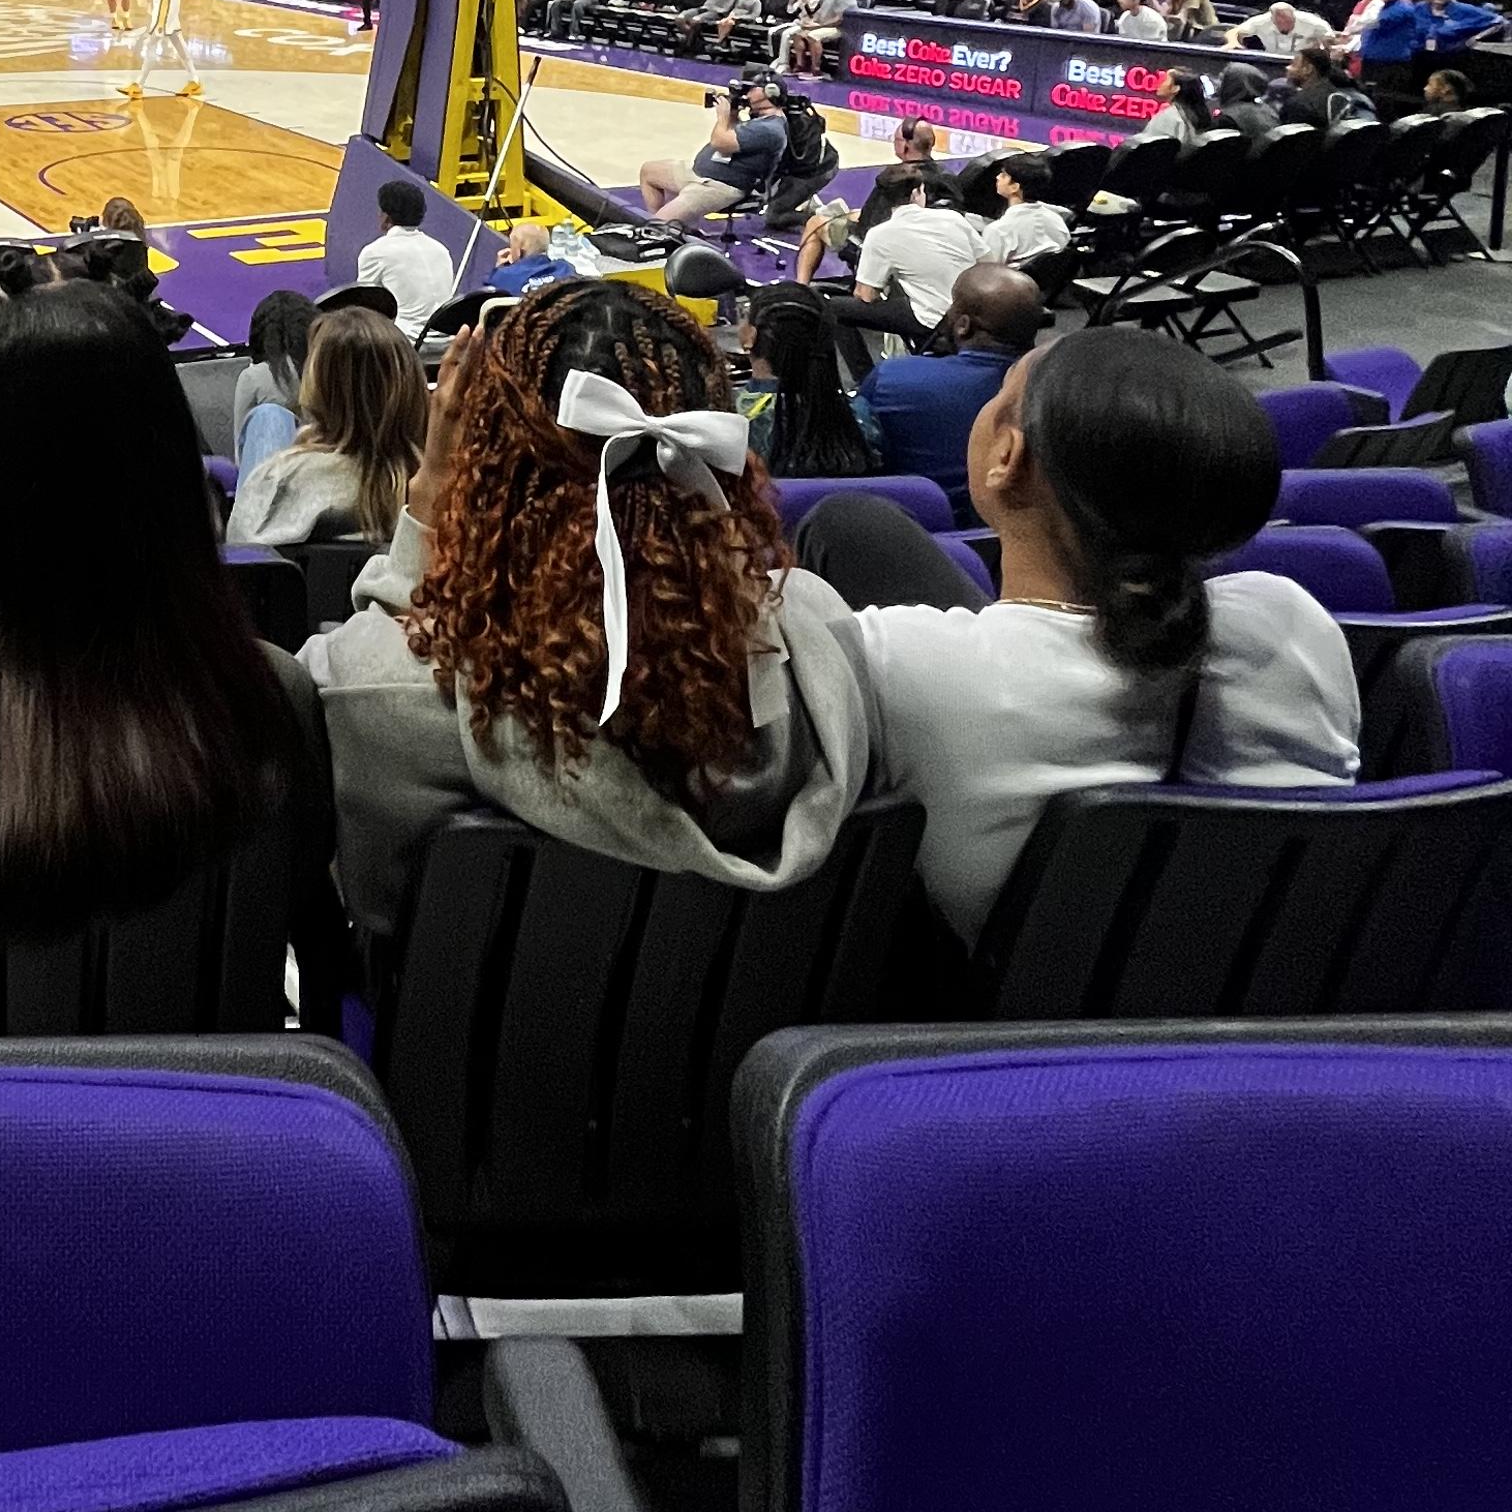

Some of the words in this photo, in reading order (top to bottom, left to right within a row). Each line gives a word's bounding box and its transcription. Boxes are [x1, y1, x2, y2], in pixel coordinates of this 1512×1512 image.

[862, 33, 906, 58] Best
[906, 39, 952, 64] Coke
[952, 44, 1013, 72] Ever?
[849, 55, 892, 80] Coke
[893, 64, 946, 87] ZERO
[948, 72, 1022, 99] SUGAR
[1067, 59, 1126, 88] Best
[1051, 84, 1107, 113] Coke
